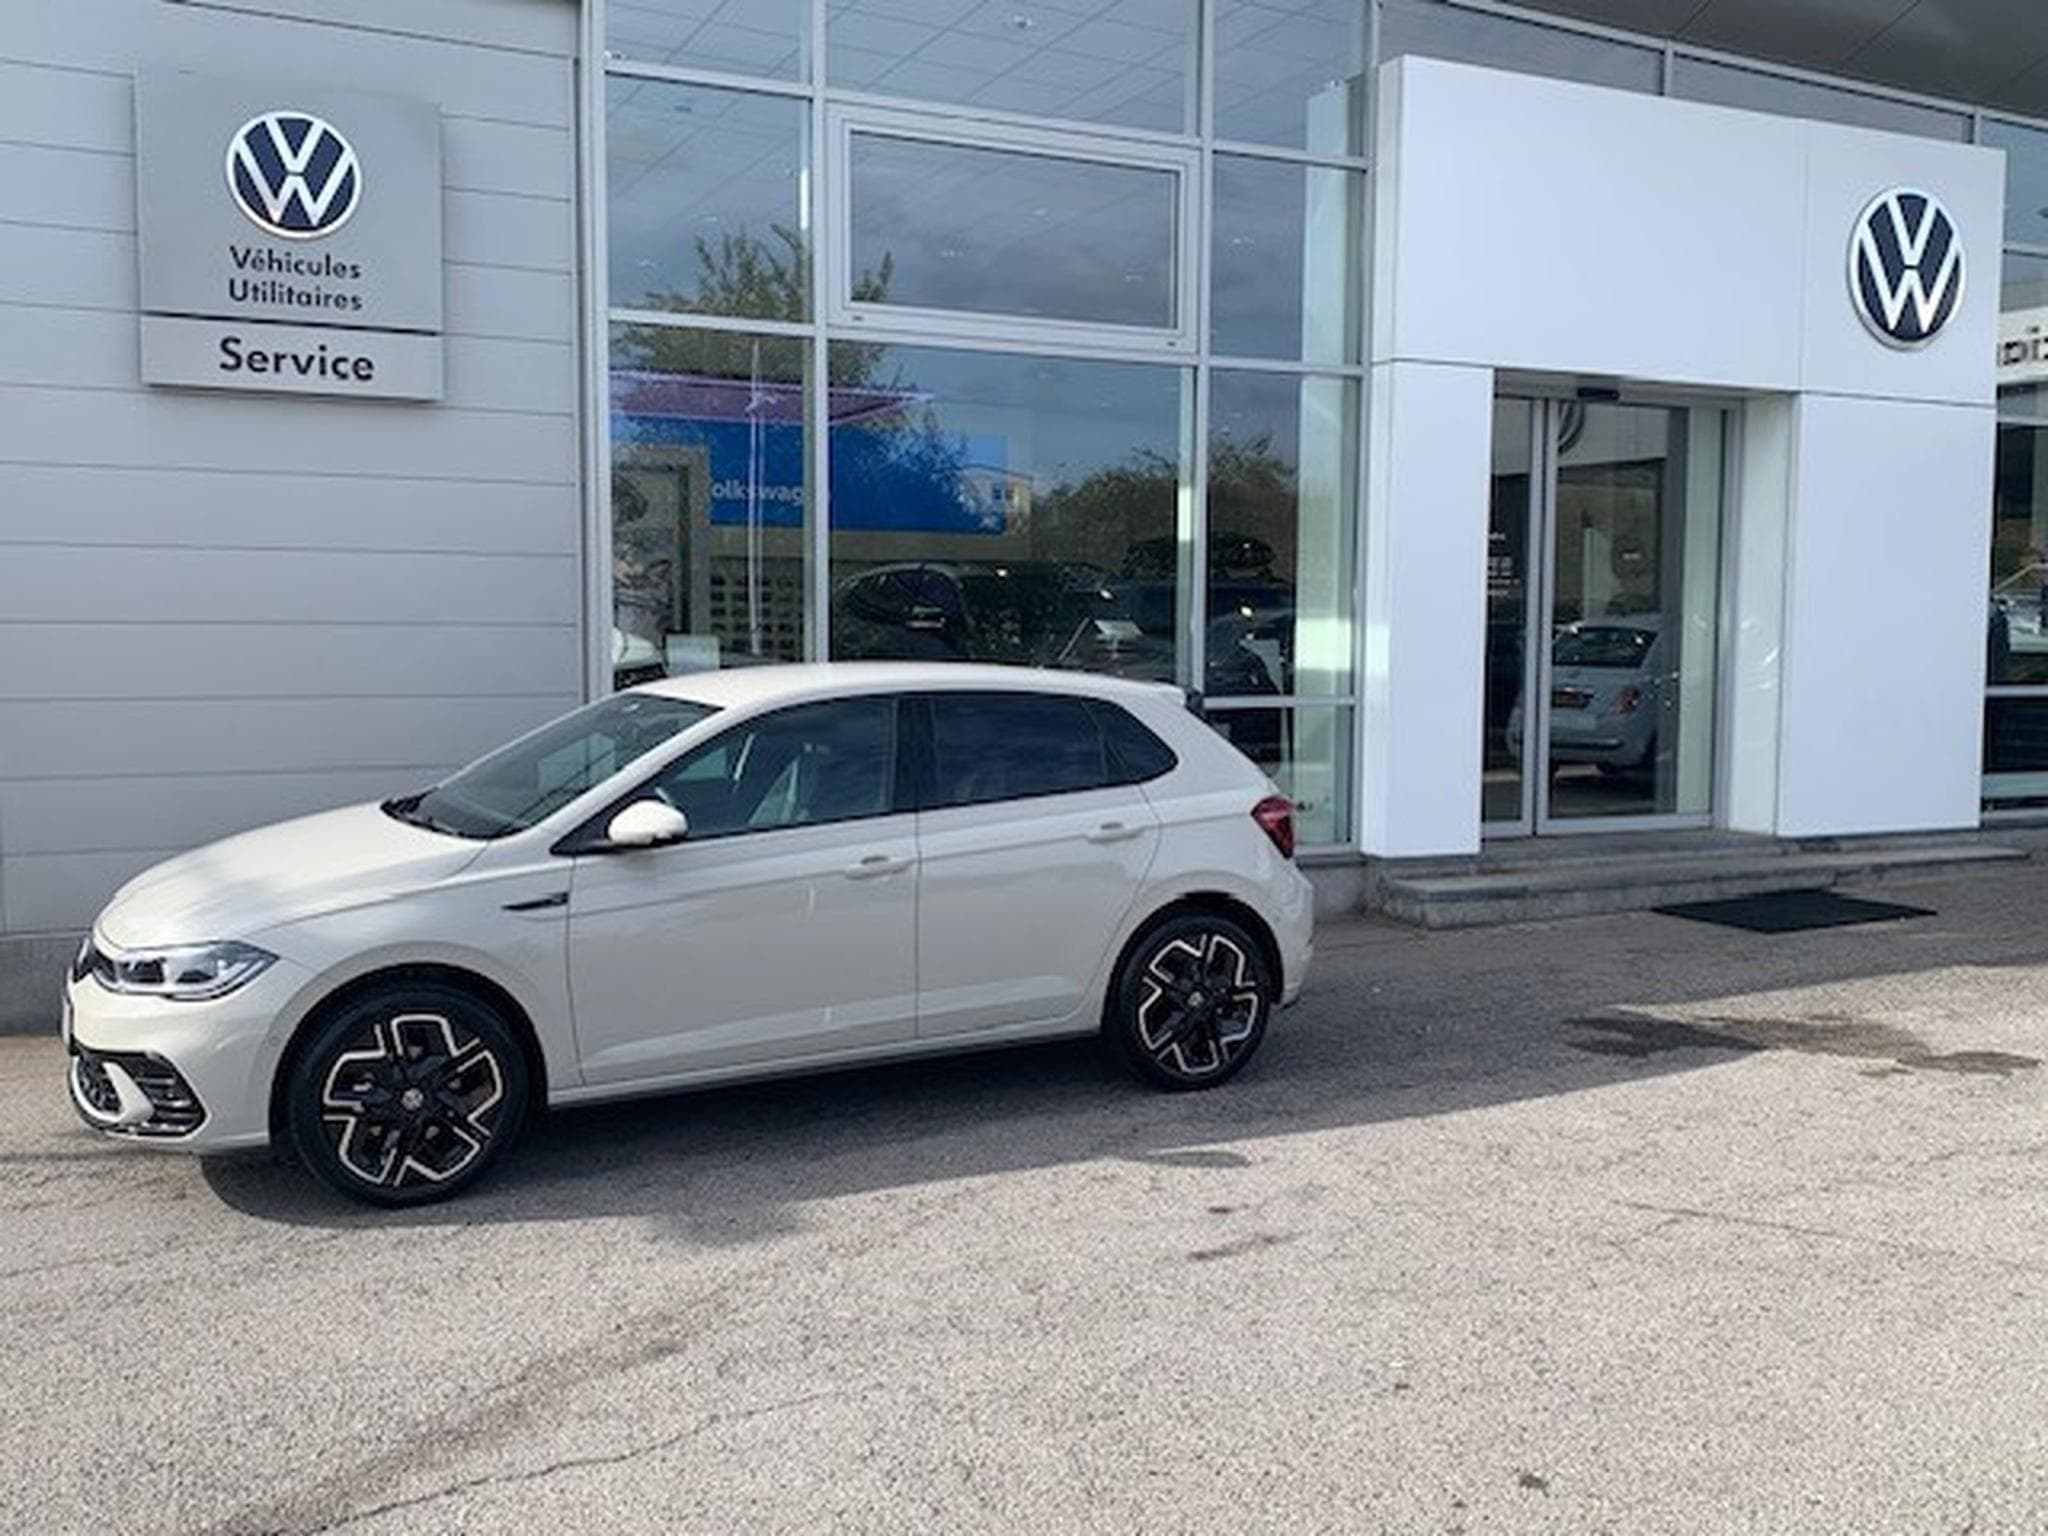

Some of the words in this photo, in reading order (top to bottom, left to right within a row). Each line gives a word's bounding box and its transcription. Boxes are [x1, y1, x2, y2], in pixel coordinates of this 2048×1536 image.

[229, 245, 361, 279] Véhicules
[229, 278, 363, 311] Utilitaires
[219, 336, 375, 381] Service
